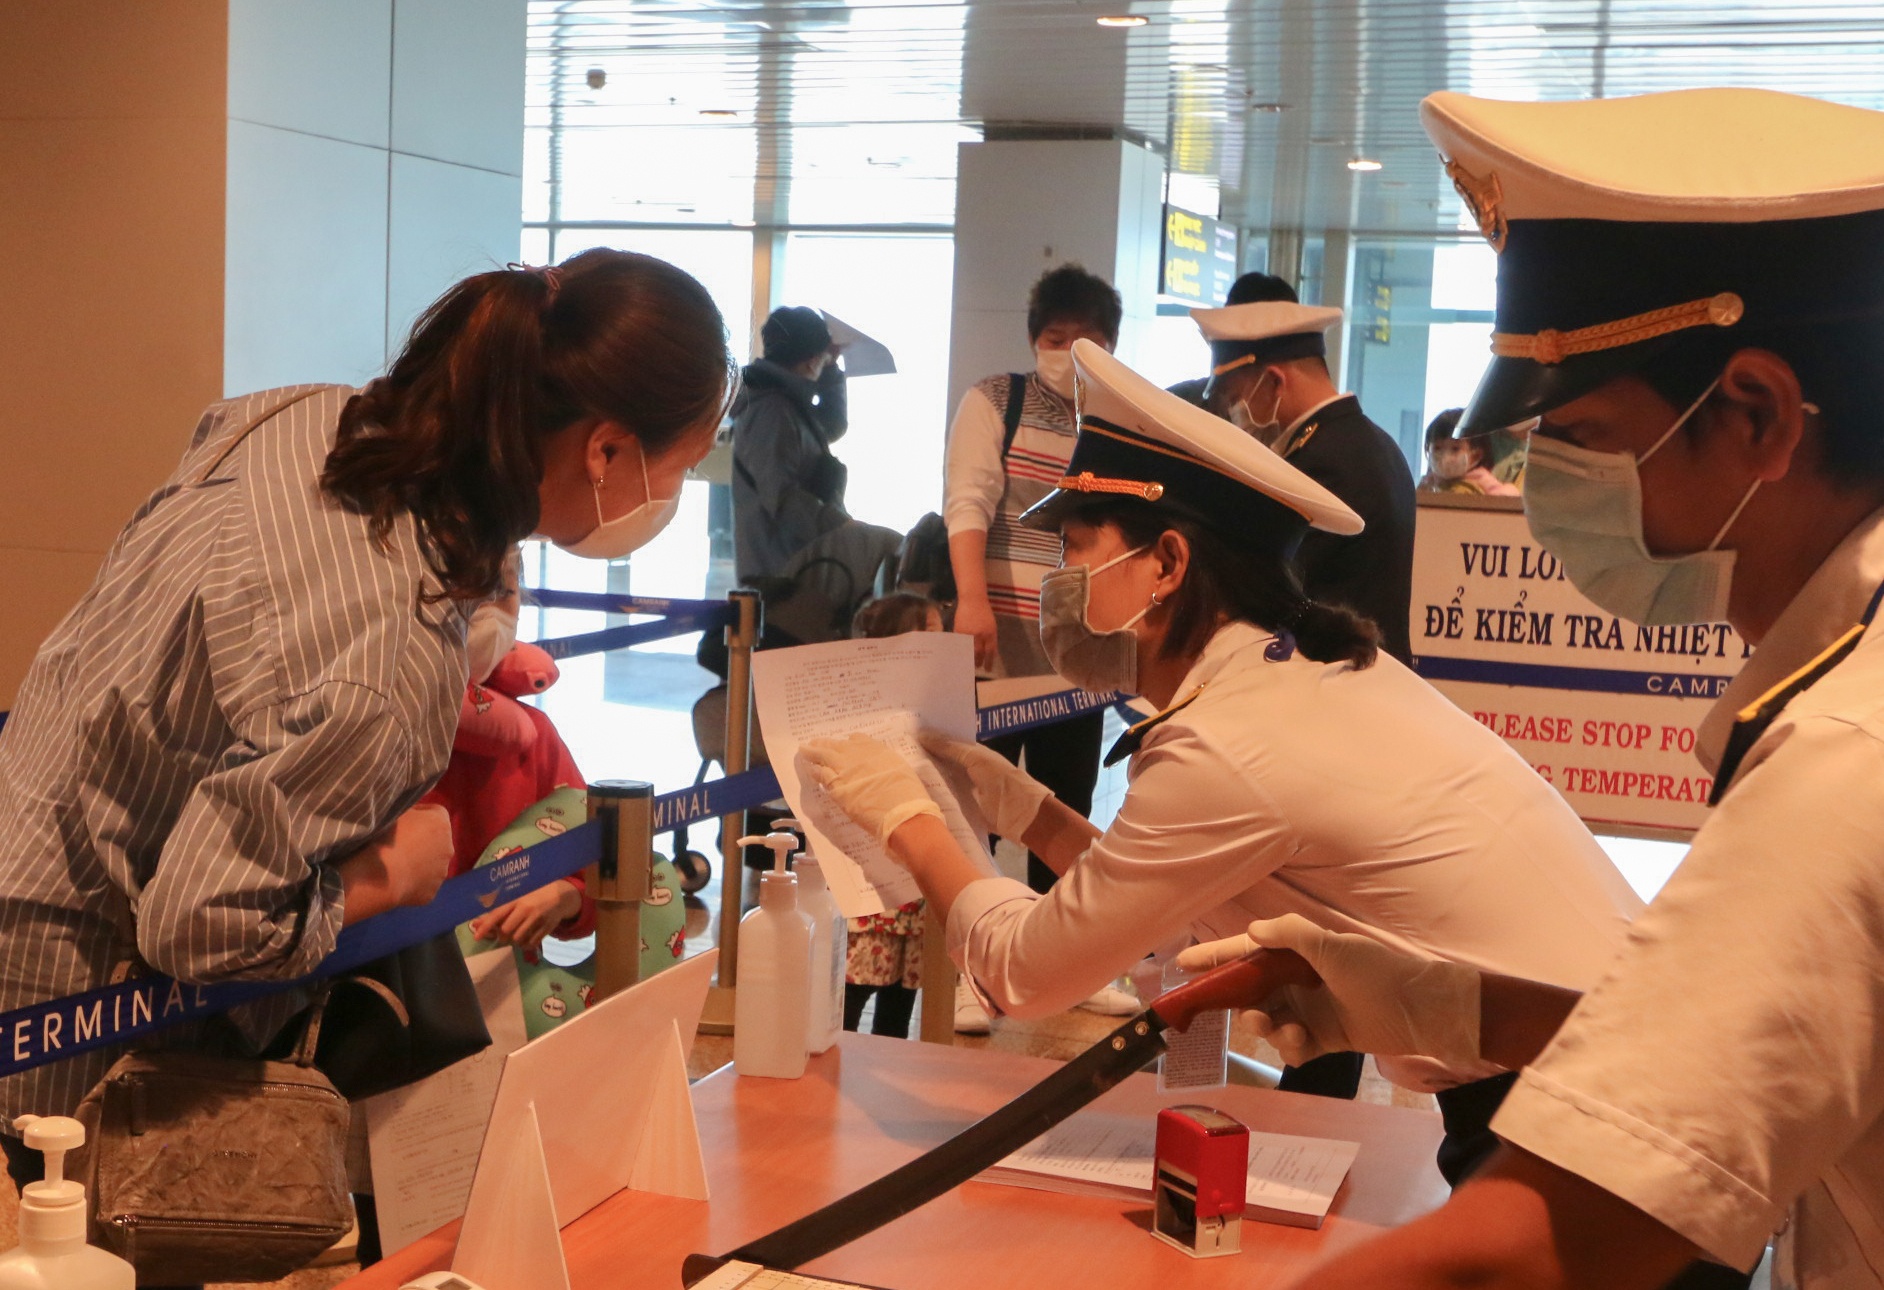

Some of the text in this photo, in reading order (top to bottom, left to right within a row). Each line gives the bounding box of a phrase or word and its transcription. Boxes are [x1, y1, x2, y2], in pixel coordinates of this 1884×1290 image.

[1461, 543, 1565, 581] VUI LO
[1424, 586, 1464, 639] ĐỂ
[1474, 590, 1554, 646] KIỂM
[1564, 614, 1625, 651] TRA
[988, 695, 1070, 731] INTERNATIONAL
[1072, 690, 1118, 711] TERMINAL
[1582, 720, 1652, 749] STOP
[1659, 726, 1695, 753] FO
[1563, 767, 1713, 804] TEMPERAT
[490, 855, 530, 882] CAMRANH
[0, 980, 207, 1061] ERMINAL
